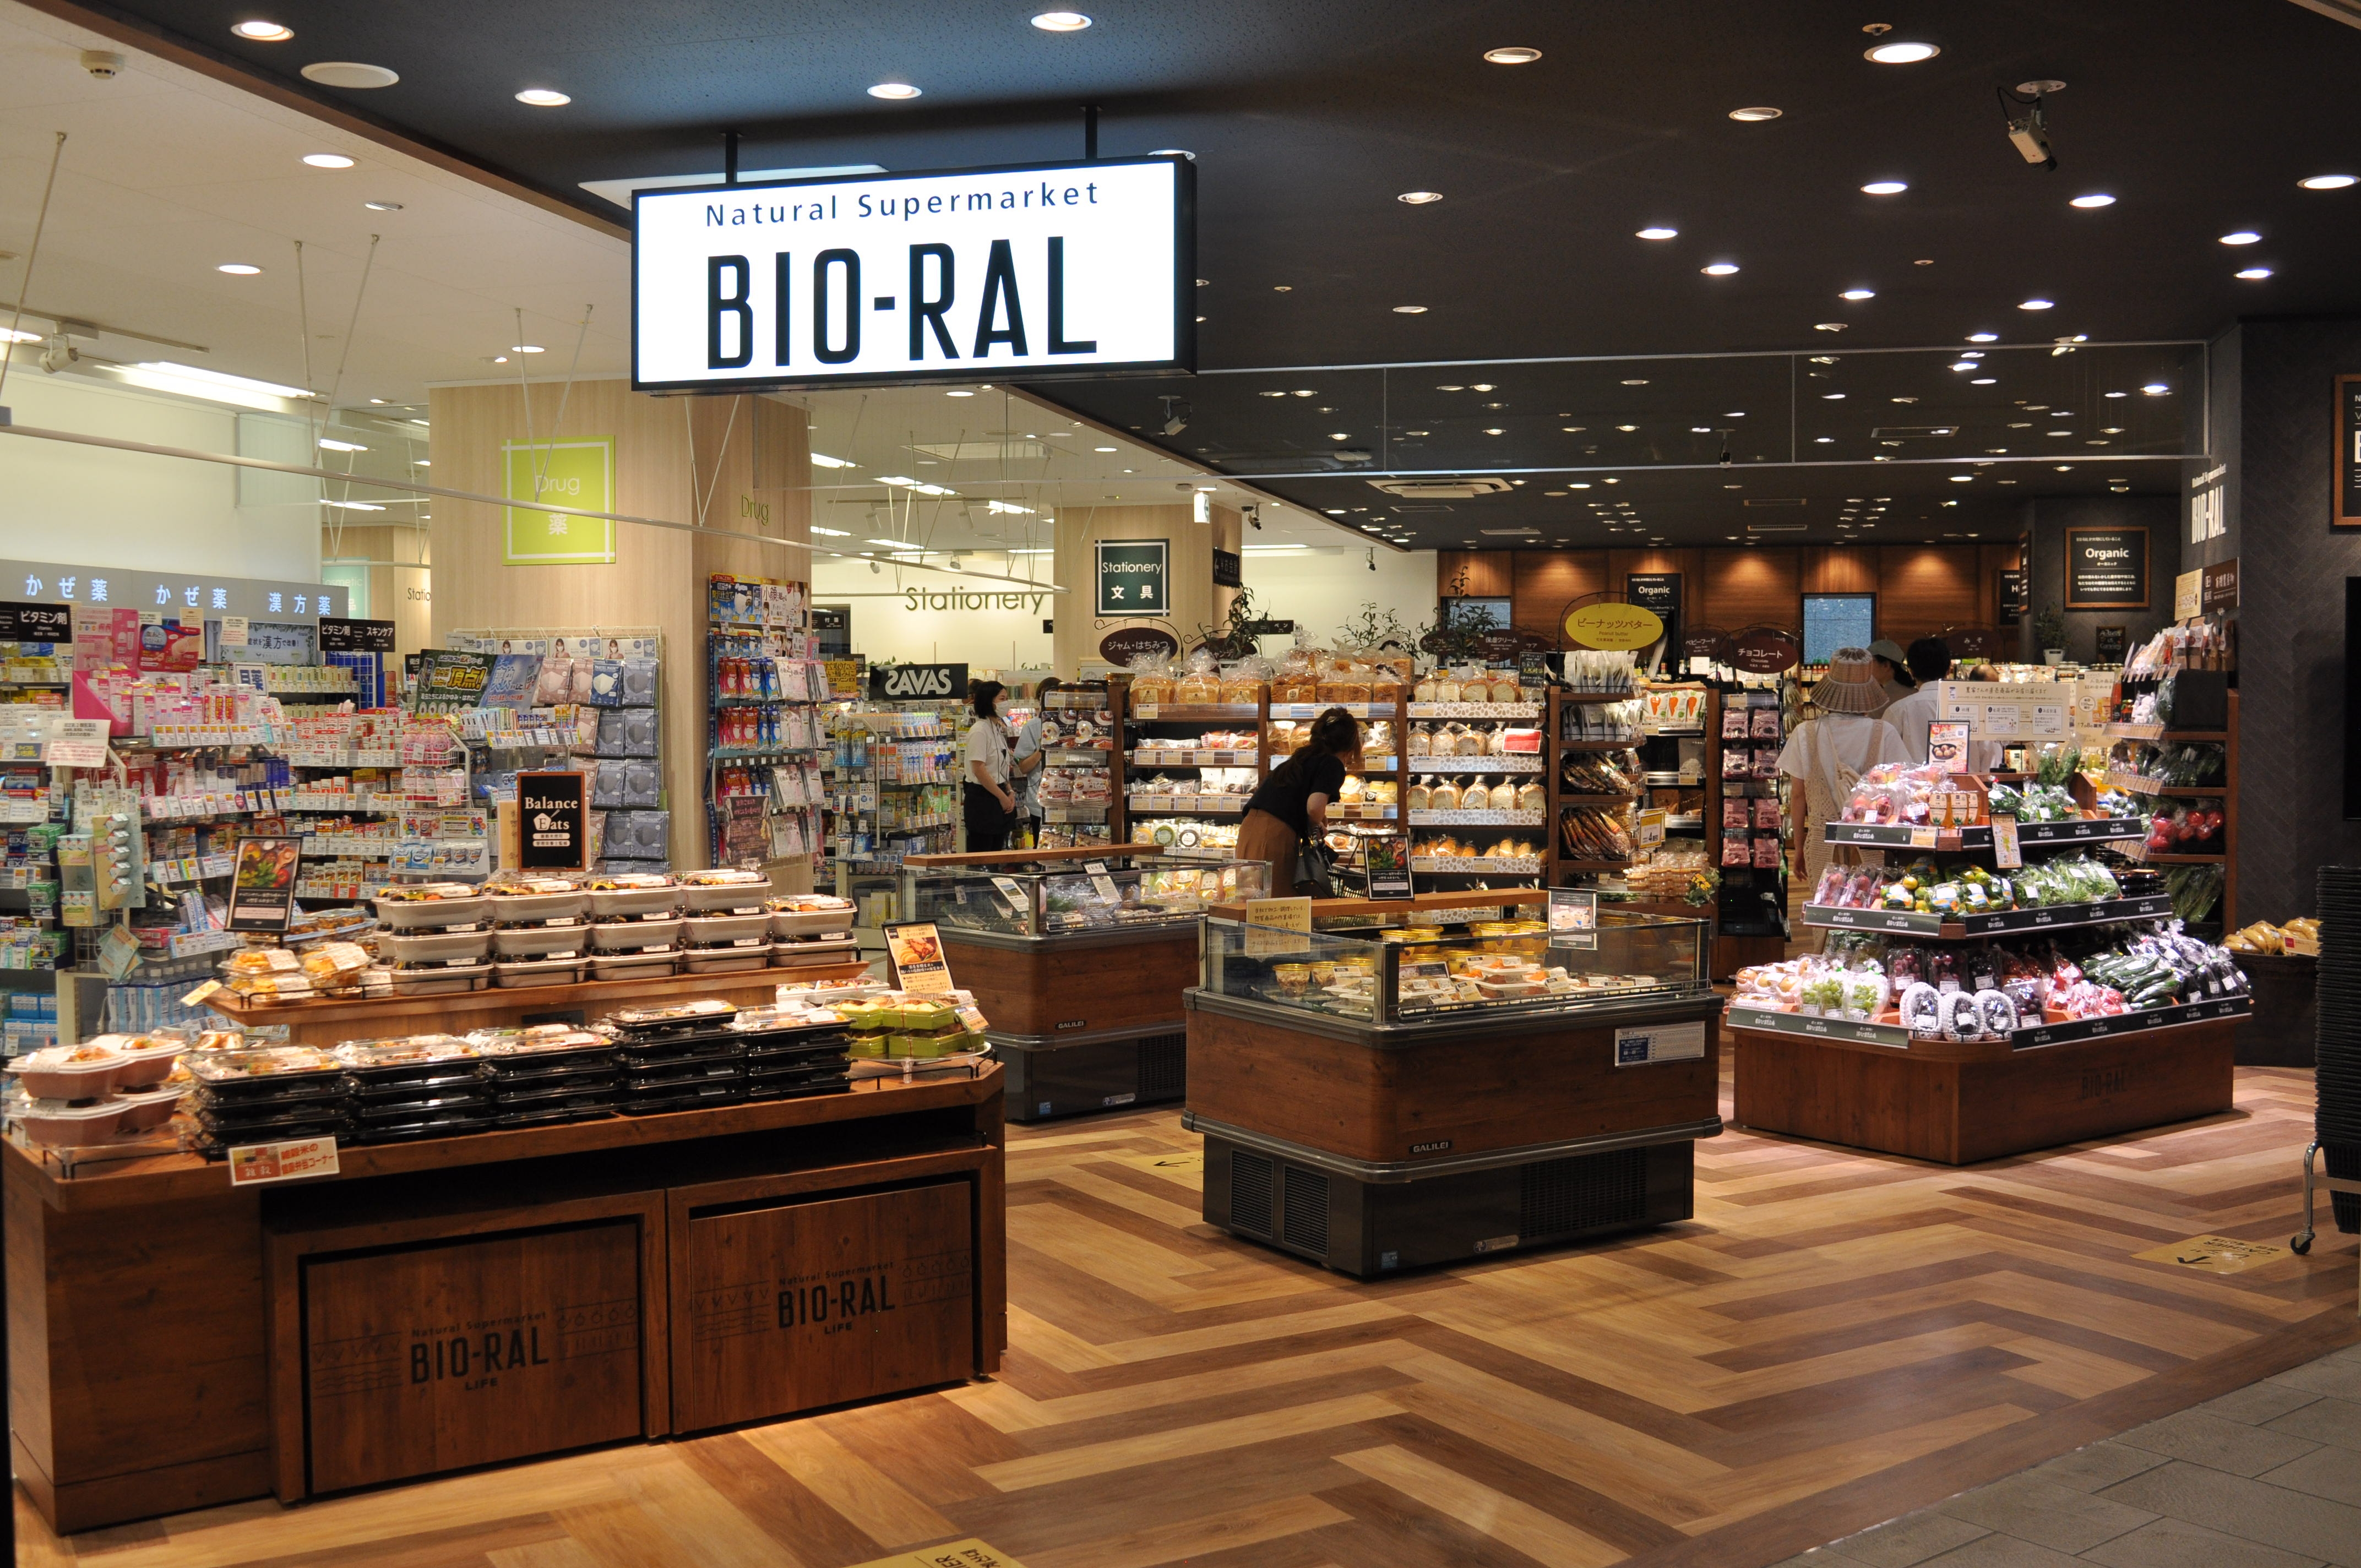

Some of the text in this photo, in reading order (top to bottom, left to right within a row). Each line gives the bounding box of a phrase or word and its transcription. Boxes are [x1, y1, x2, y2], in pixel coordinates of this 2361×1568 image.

[706, 182, 1098, 227] Natural Supermarket
[708, 236, 1097, 369] BIO-RAL
[535, 474, 580, 496] Drug
[741, 494, 769, 526] Drug
[2191, 485, 2226, 544] BIO-RAL
[548, 514, 568, 535] 薬
[2085, 548, 2129, 560] Organic
[1102, 562, 1162, 575] Stationery
[26, 574, 108, 602] かぜ薬
[1111, 585, 1154, 600] 文具
[1639, 586, 1670, 595] Organic
[156, 584, 227, 609] かぜ薬
[269, 592, 331, 616] 漢方薬
[906, 586, 1045, 614] Stationery
[20, 611, 68, 625] ビタミン剤
[1577, 618, 1653, 630] ピーナッツバター
[322, 625, 351, 636] ビタミン剤
[367, 626, 394, 638] スキンケア
[1108, 640, 1169, 651] ジャム・はちみつ
[1737, 647, 1783, 659] チョコレート
[240, 668, 264, 692] 目薬
[447, 666, 487, 690] 頂点!
[885, 668, 952, 695] SAVAS
[525, 796, 578, 809] Balance
[539, 818, 570, 830] Eats
[9, 836, 22, 844] EX
[7, 858, 21, 868] EX
[281, 1142, 319, 1160] 雑穀米の
[1413, 1141, 1449, 1153] GALILEI
[2203, 1241, 2271, 1255] CASHIER
[780, 1261, 894, 1286] Natural Supermarket
[778, 1275, 896, 1329] BIO-RAL
[413, 1311, 547, 1337] Natural Supermarket
[824, 1322, 852, 1335] LIFE
[411, 1326, 549, 1384] BIO-RAL
[465, 1377, 498, 1391] LIFE
